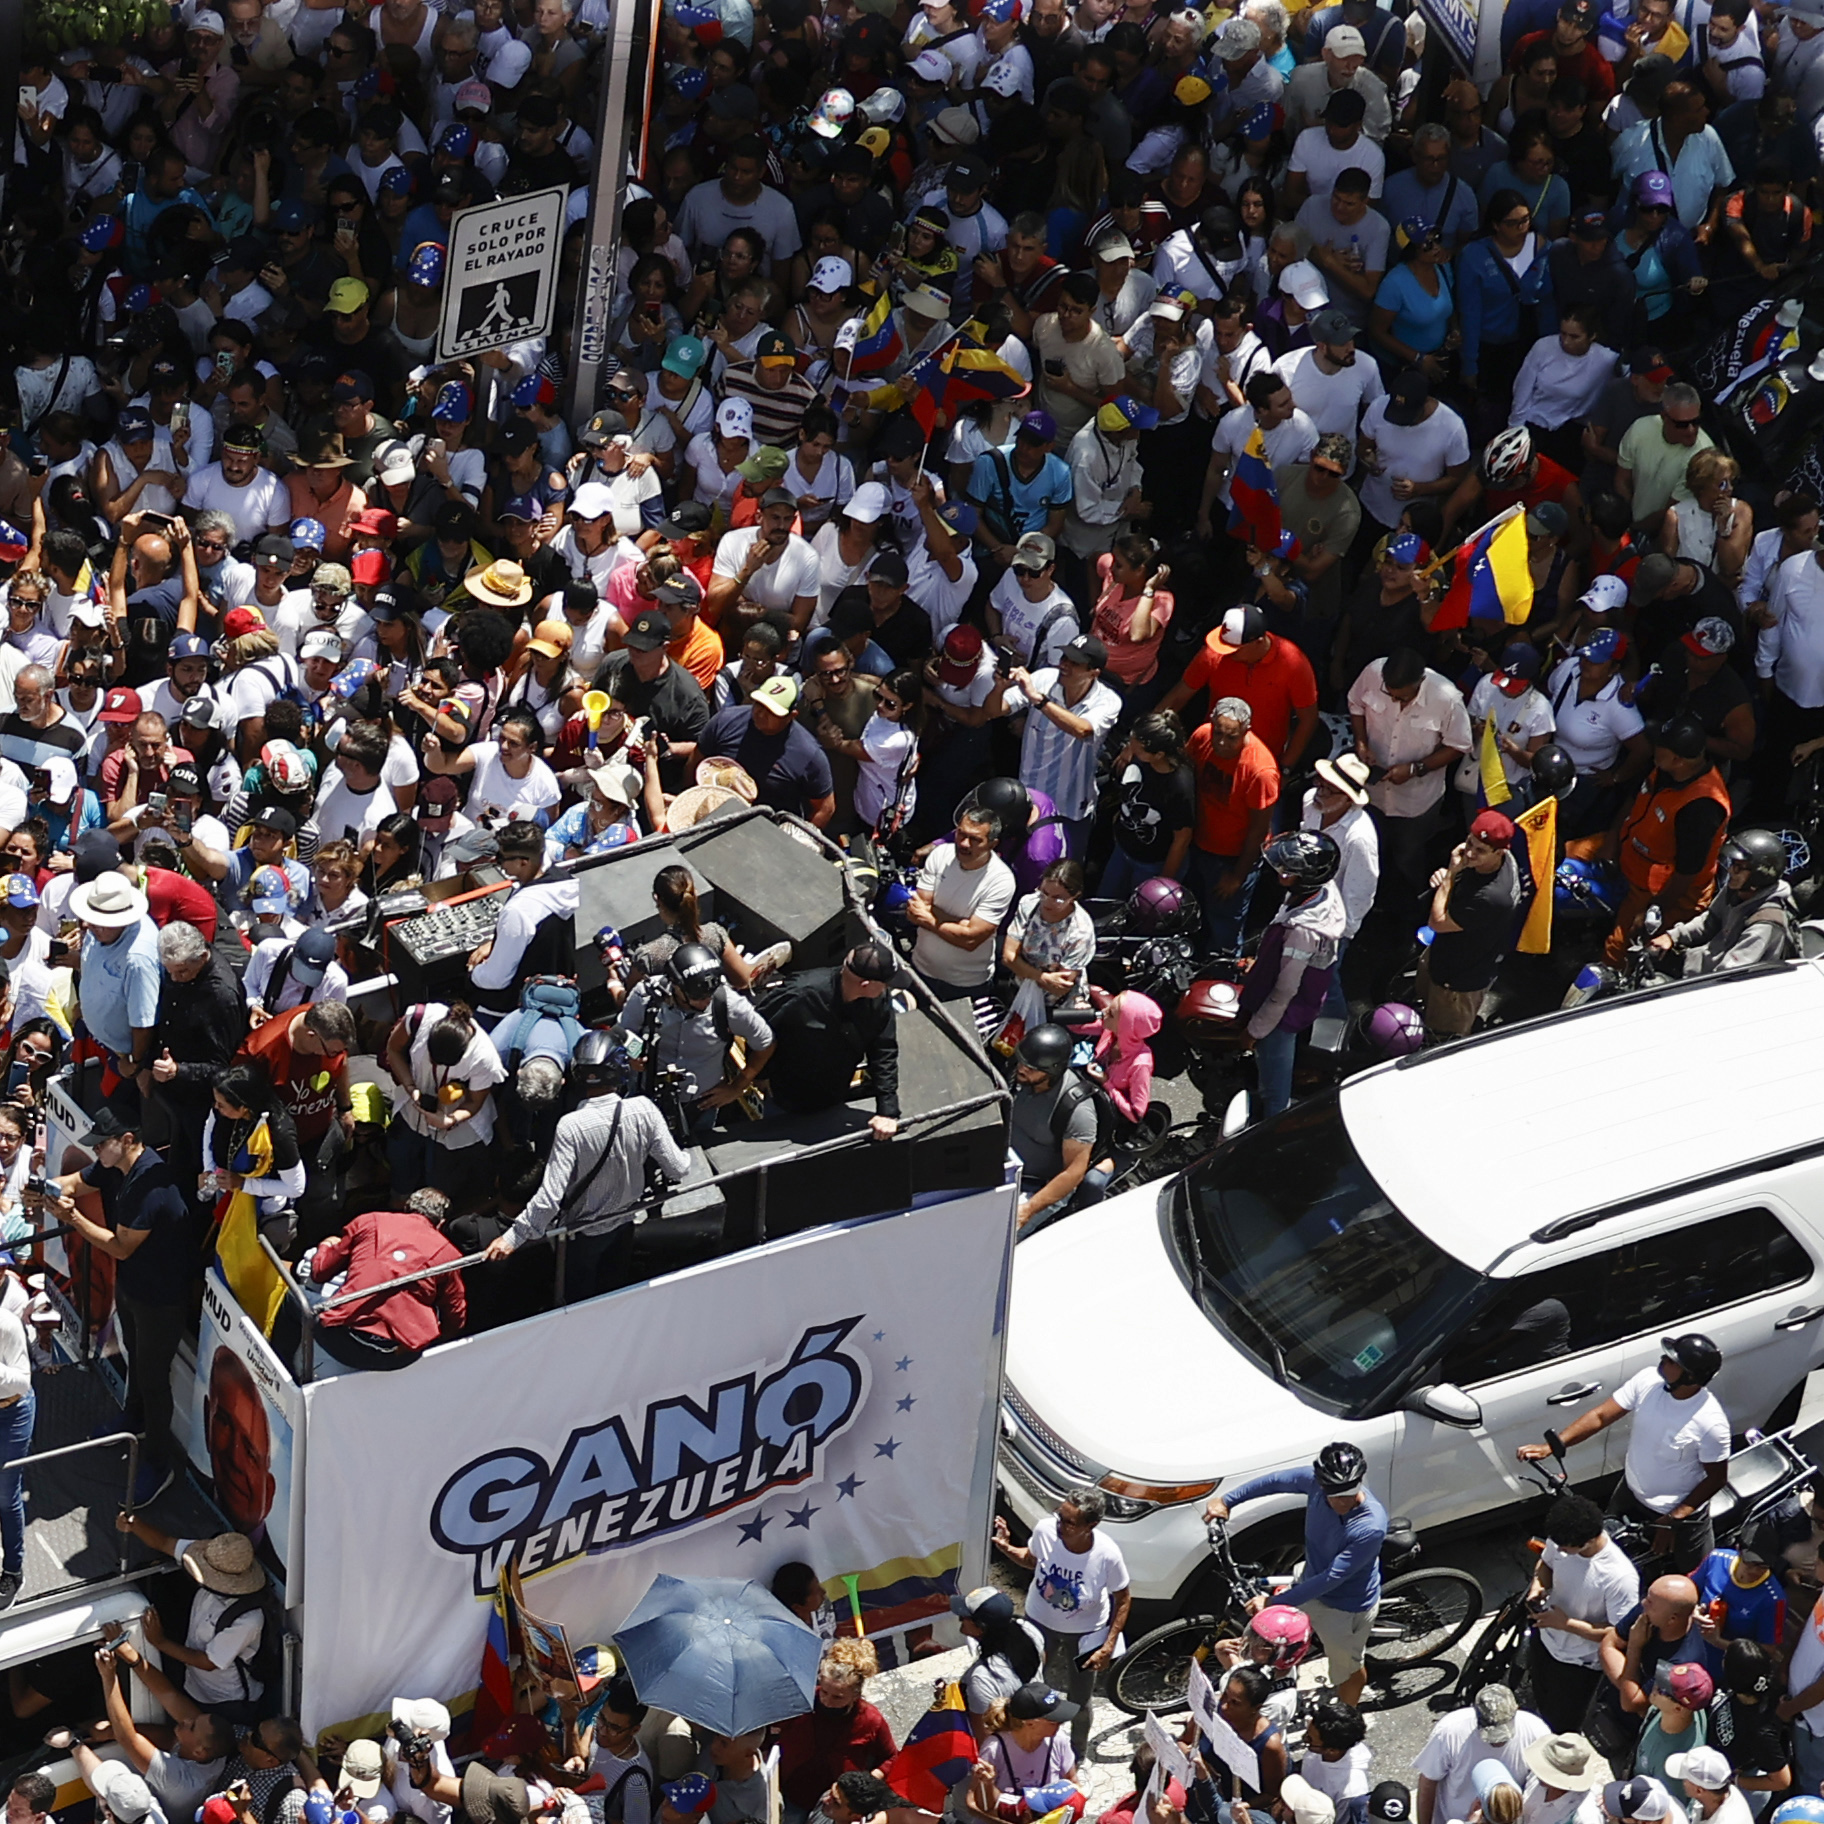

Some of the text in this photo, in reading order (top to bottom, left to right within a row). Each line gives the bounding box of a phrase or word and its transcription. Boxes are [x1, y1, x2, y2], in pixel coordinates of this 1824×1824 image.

[479, 212, 539, 236] CRUCE
[467, 227, 547, 255] SOLO POR
[464, 243, 544, 272] EL RAYADO
[1727, 299, 1775, 378] Venezuela
[291, 1077, 310, 1101] Yo
[204, 1279, 231, 1333] MUD
[433, 1316, 862, 1551] GANÓ
[480, 1430, 813, 1588] VENEZUELA
[1036, 1563, 1084, 1591] SMILE
